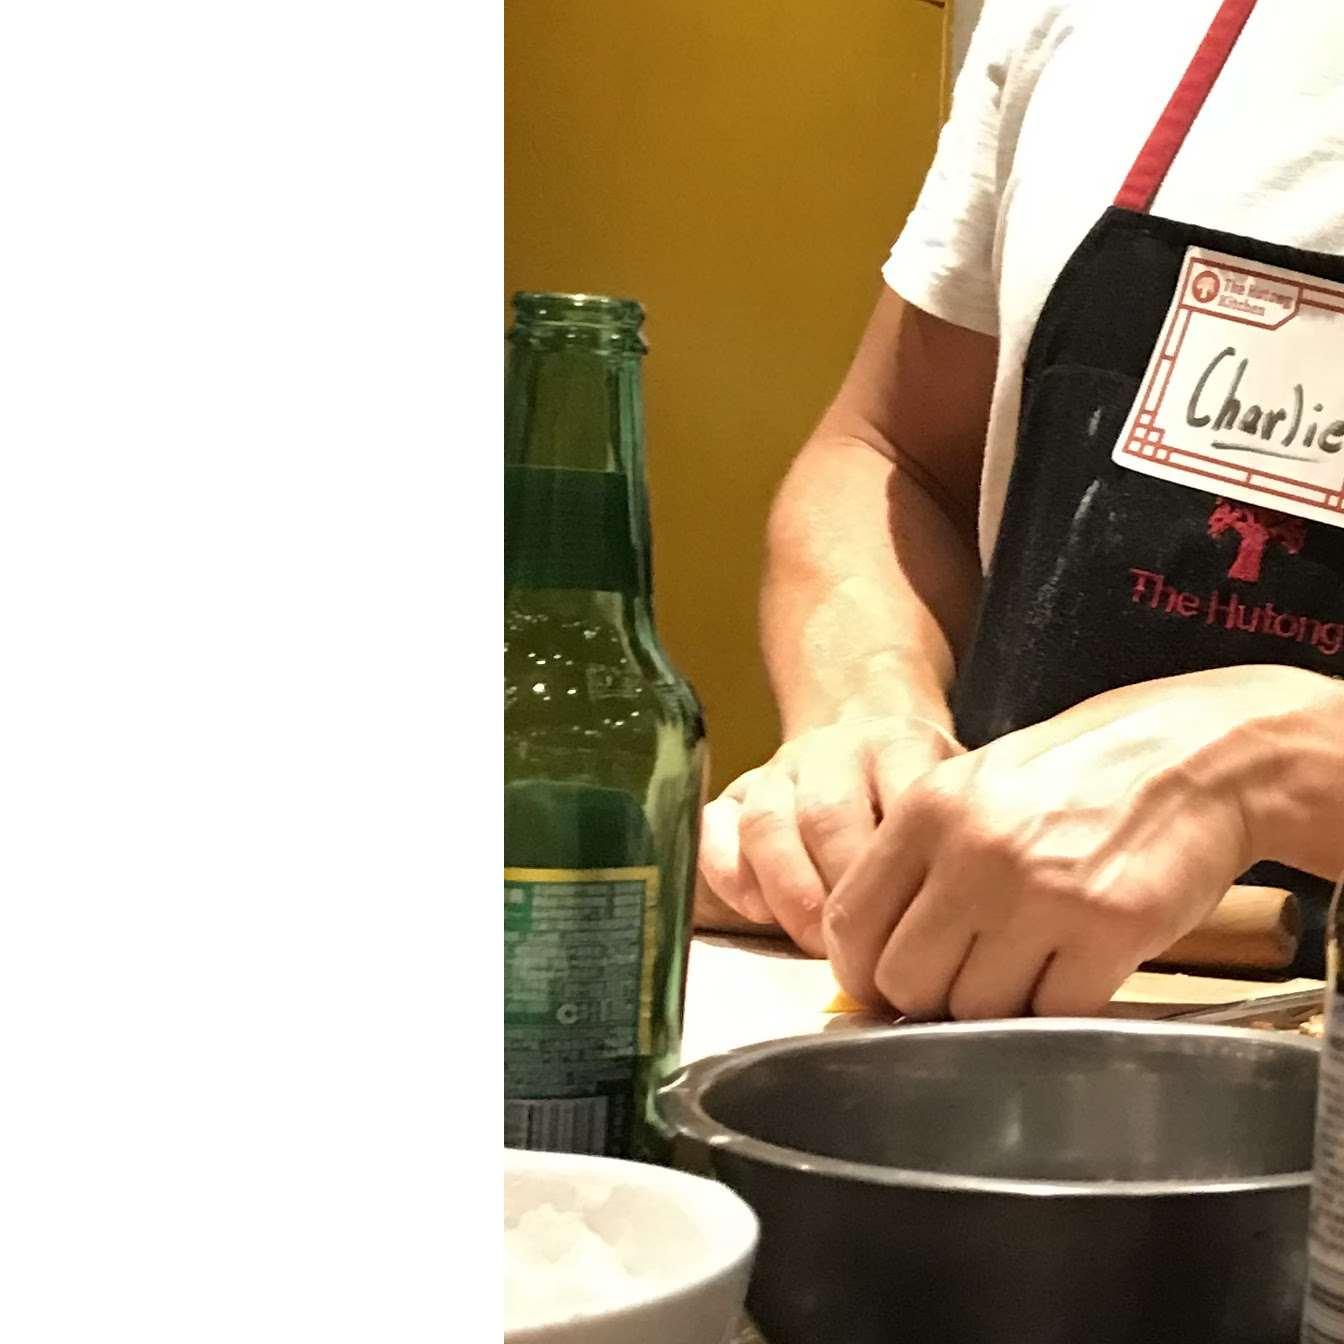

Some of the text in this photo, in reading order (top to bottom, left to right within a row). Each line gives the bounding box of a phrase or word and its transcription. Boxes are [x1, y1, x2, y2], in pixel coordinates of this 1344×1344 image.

[1218, 295, 1265, 316] Kitchen
[1223, 277, 1294, 309] The Hutong
[1130, 567, 1344, 655] The Hutong
